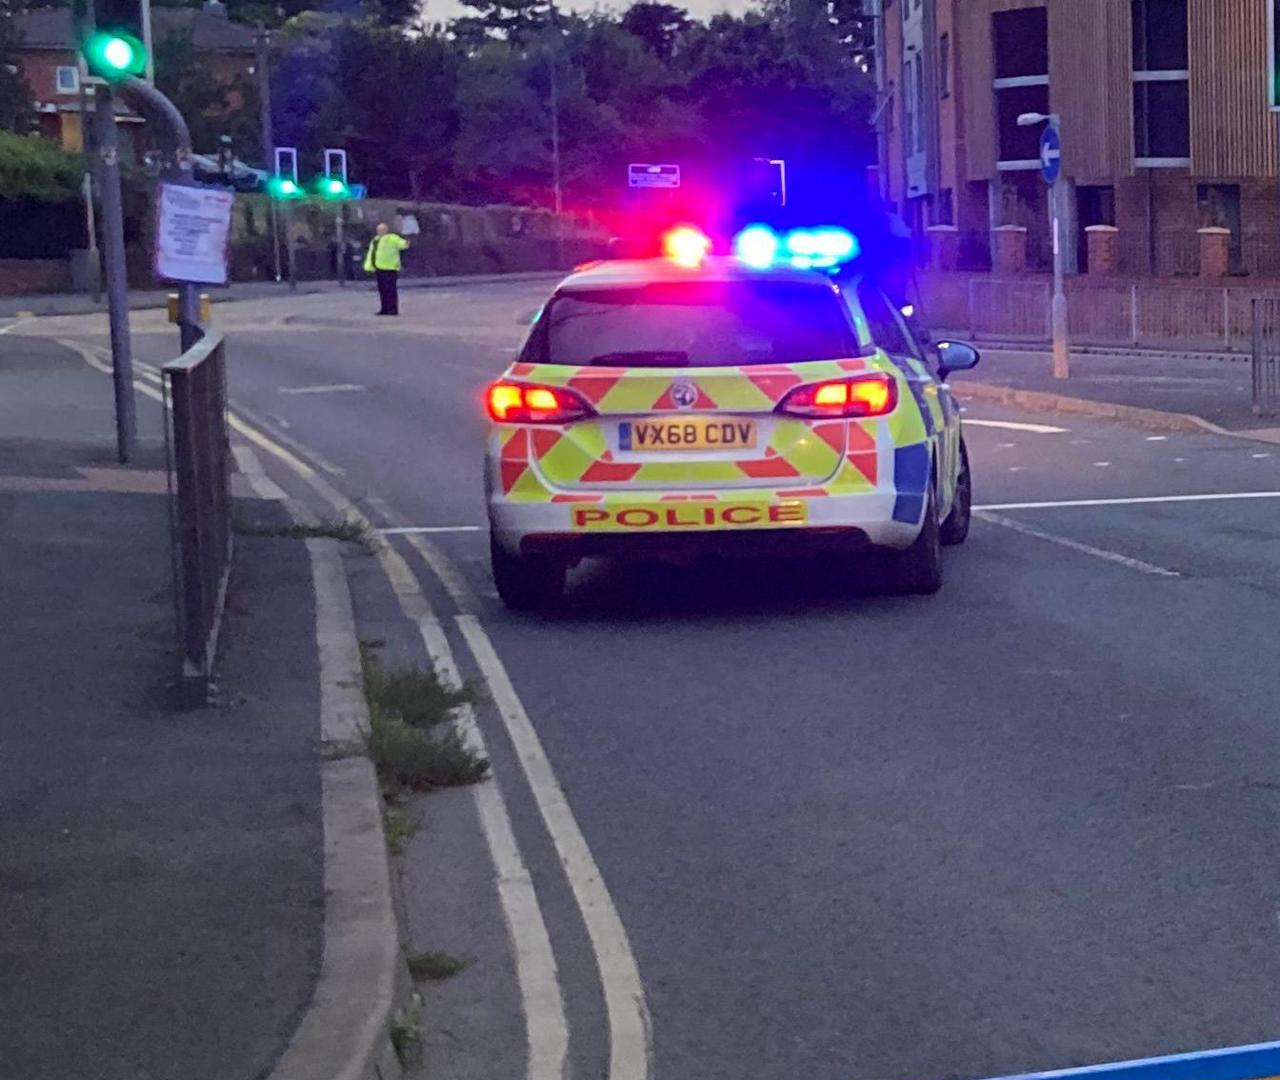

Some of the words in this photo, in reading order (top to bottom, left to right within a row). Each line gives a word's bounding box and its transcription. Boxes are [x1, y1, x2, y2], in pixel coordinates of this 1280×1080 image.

[635, 424, 697, 444] VX68
[705, 423, 751, 444] CDV
[575, 505, 804, 527] POLICE
